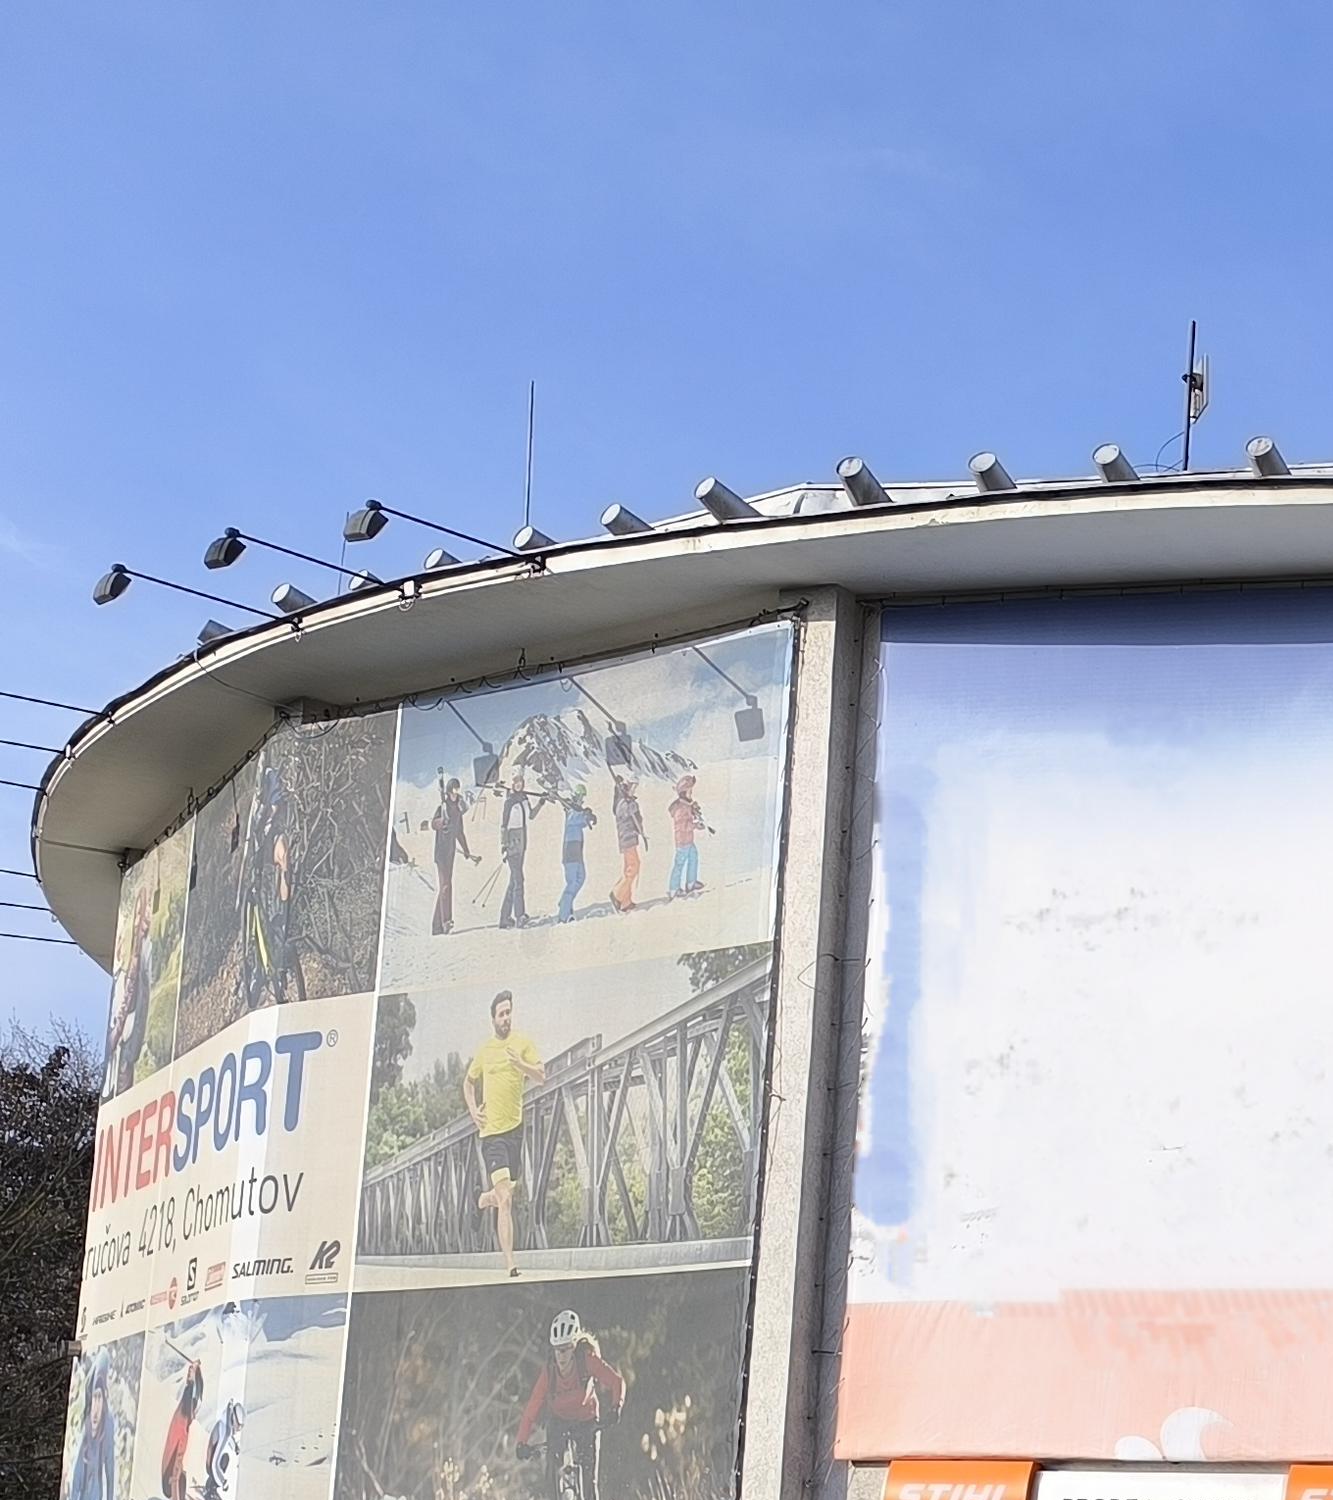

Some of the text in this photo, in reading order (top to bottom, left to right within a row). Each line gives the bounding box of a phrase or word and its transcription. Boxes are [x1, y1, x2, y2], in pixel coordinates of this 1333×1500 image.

[138, 1196, 176, 1258] 4218,
[182, 1166, 305, 1241] Chomutov
[309, 1240, 340, 1270] K2
